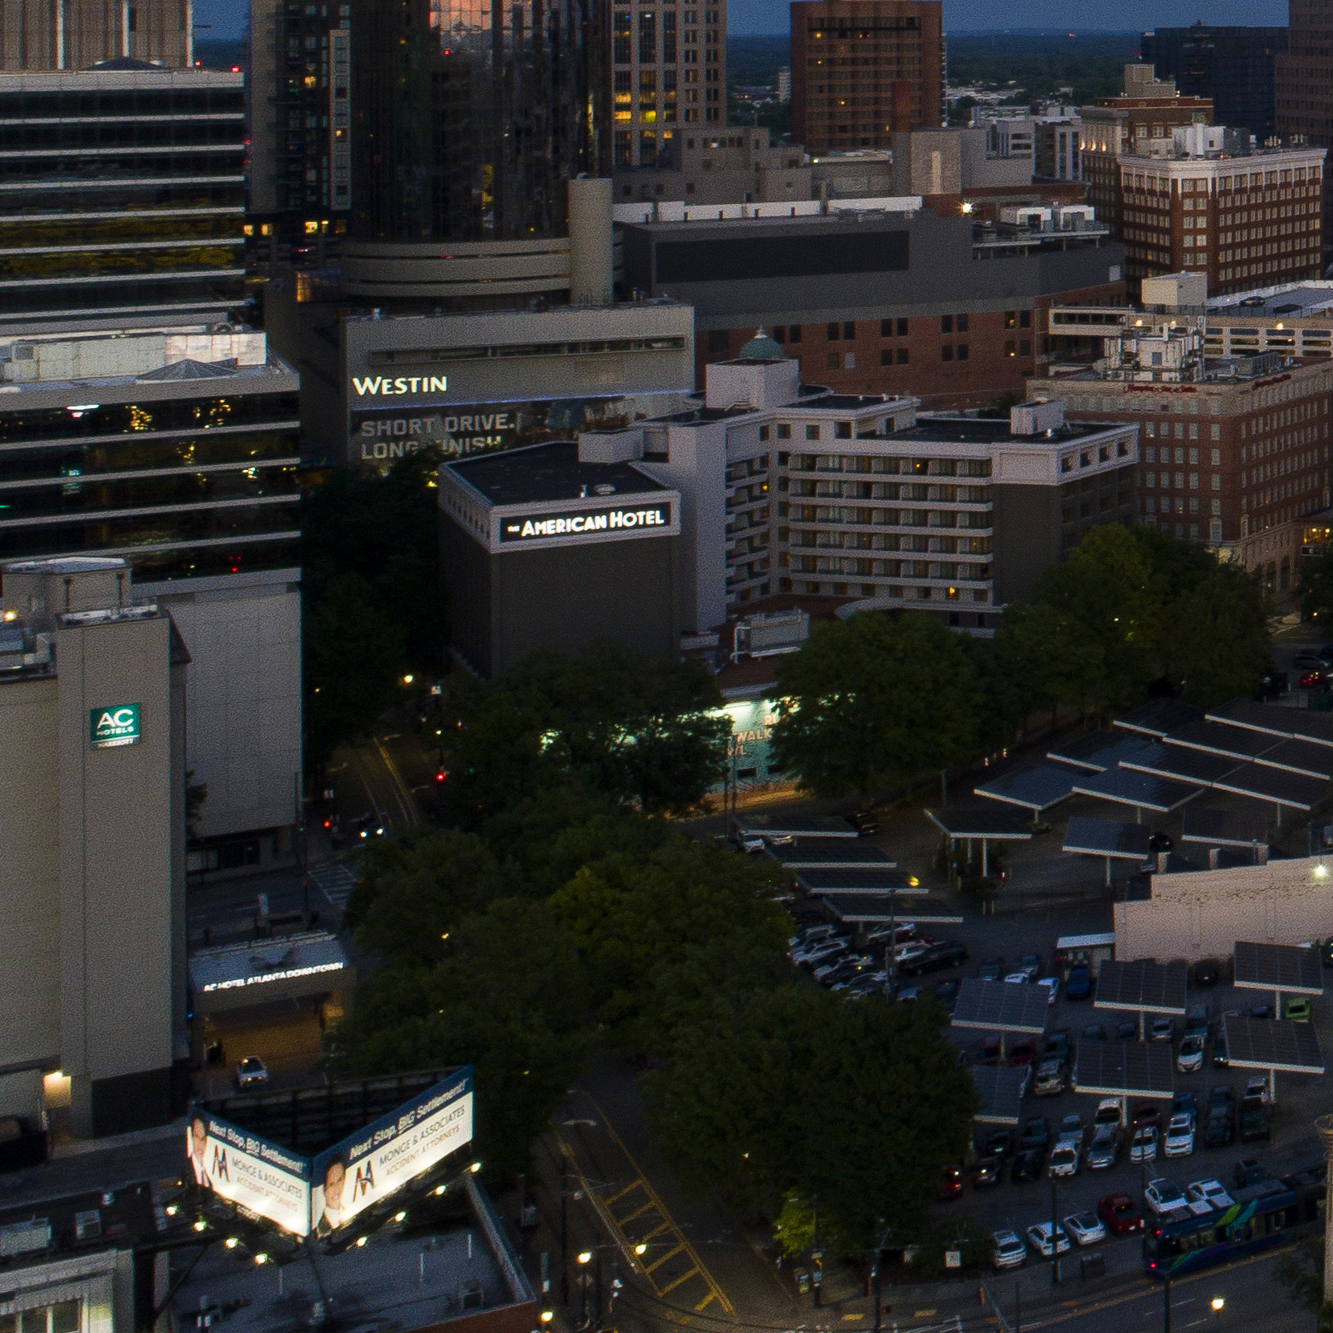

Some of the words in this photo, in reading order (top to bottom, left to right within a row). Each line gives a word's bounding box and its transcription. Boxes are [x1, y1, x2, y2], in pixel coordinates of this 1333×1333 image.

[352, 376, 448, 396] WESTIN
[361, 417, 435, 437] SHORT
[521, 515, 608, 537] AMERICAN
[609, 510, 665, 528] HOTEL
[97, 708, 134, 729] AC
